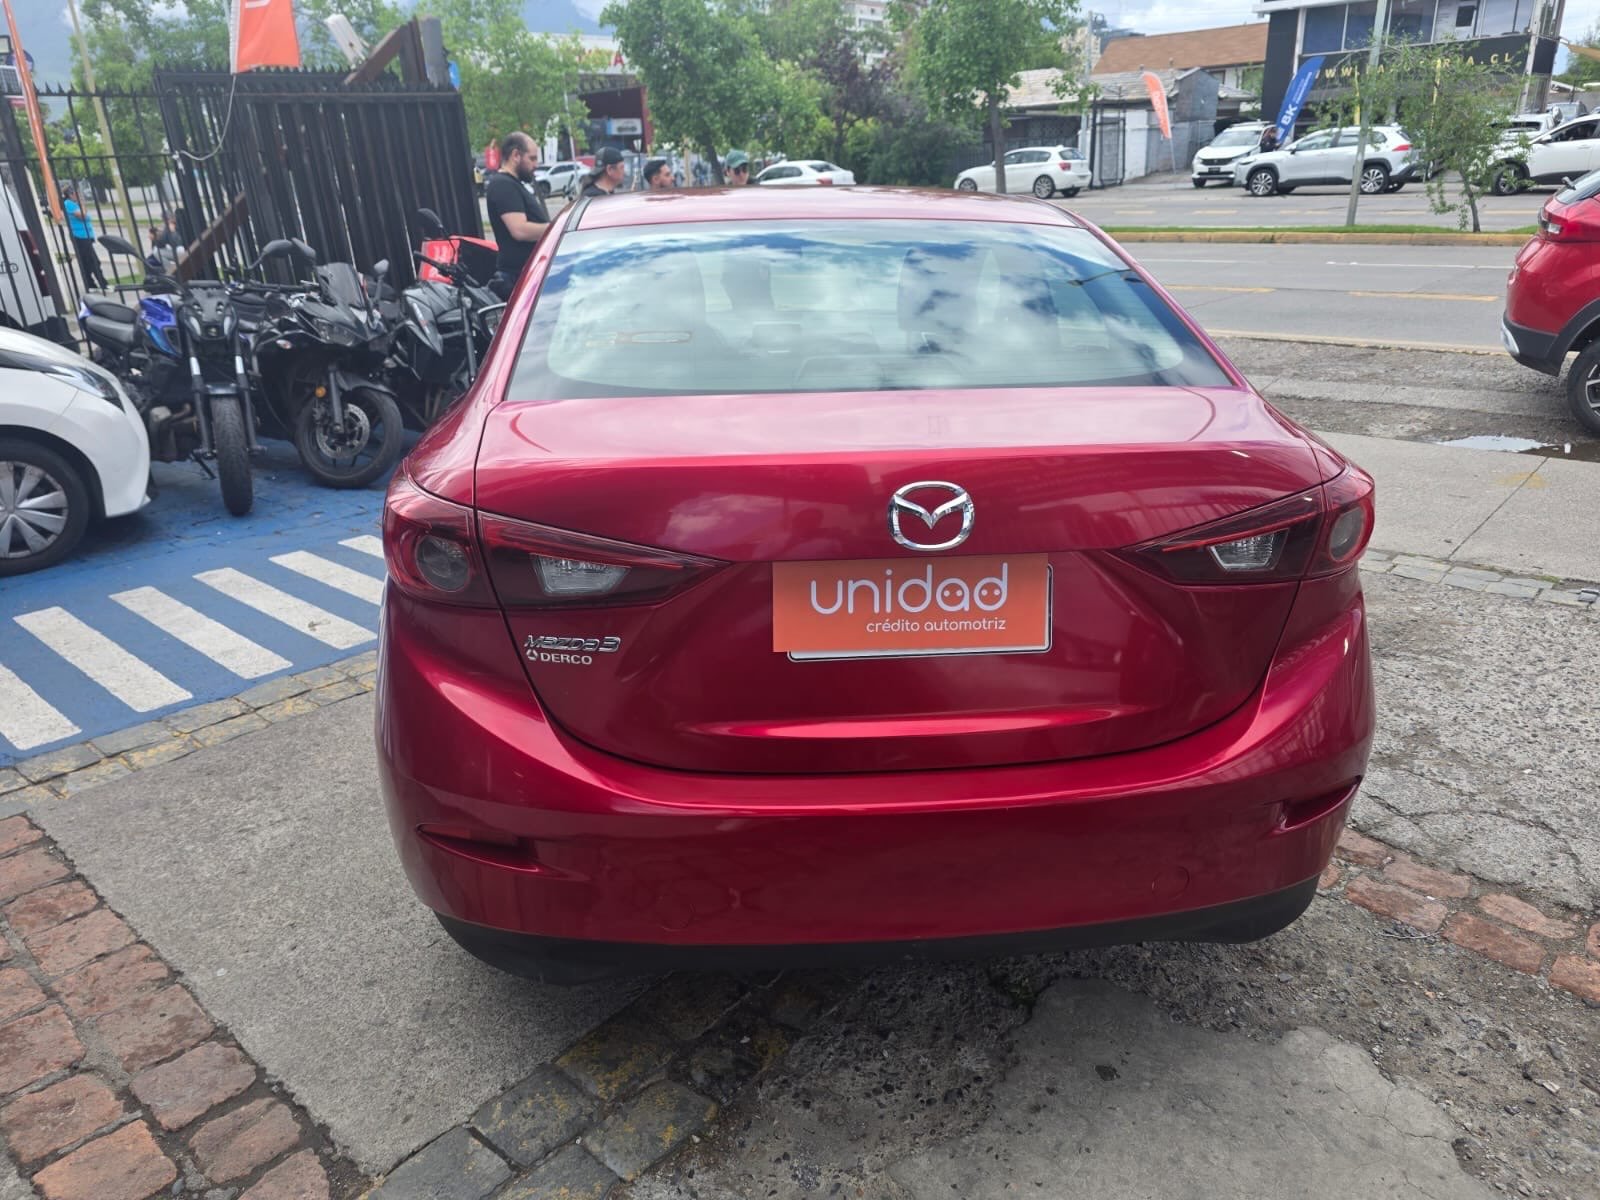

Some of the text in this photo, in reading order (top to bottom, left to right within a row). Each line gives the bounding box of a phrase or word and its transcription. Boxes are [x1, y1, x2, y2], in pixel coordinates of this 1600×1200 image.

[811, 562, 1008, 615] unidad
[866, 617, 1007, 633] crédito automotriz
[540, 652, 592, 665] DERCO
